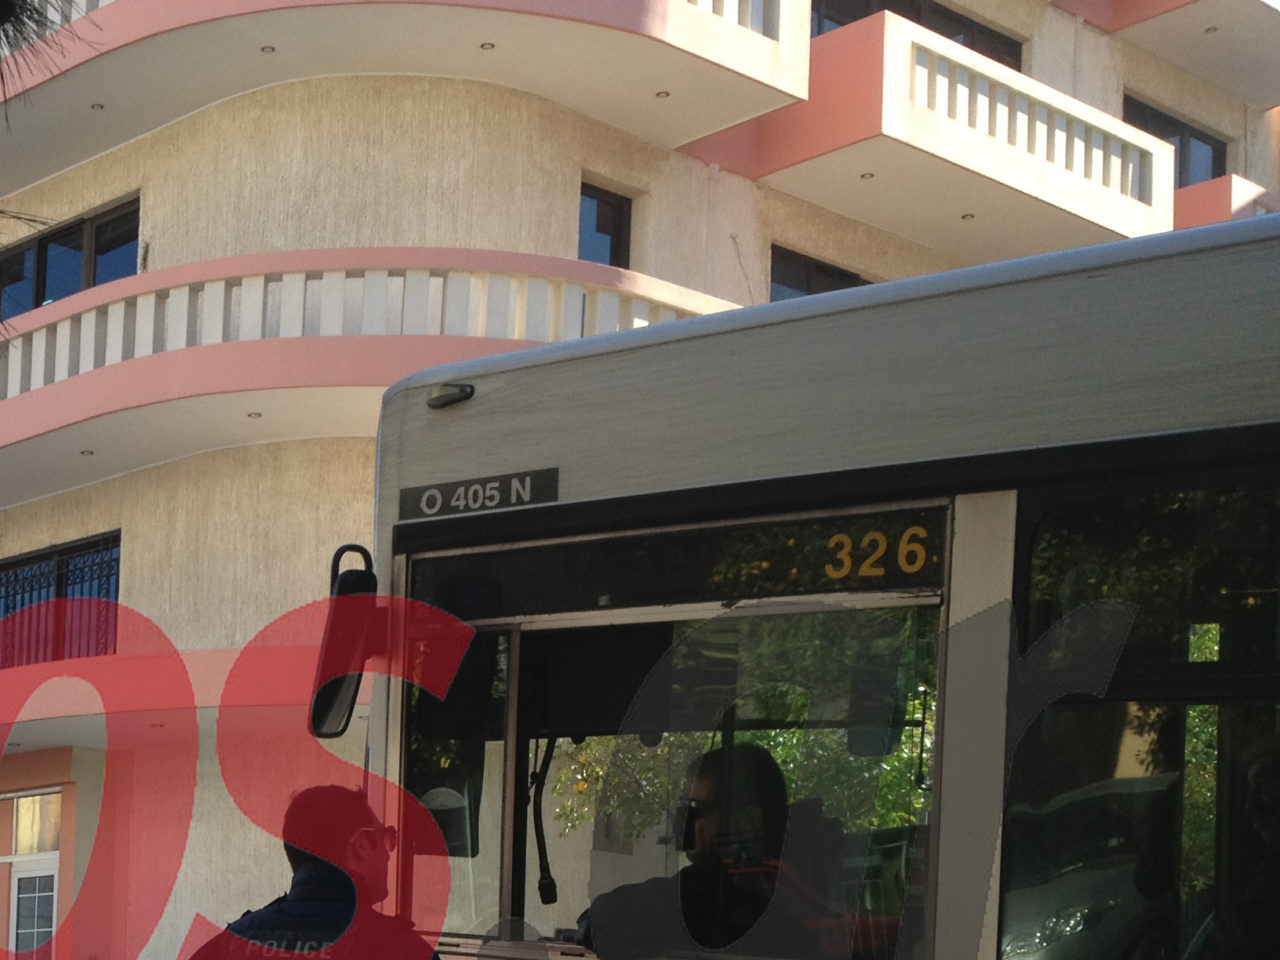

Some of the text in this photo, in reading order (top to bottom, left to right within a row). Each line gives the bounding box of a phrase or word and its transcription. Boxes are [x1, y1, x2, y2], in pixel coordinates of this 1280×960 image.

[420, 476, 532, 516] O 405 N
[824, 526, 928, 581] 326
[245, 939, 334, 959] POLICE
